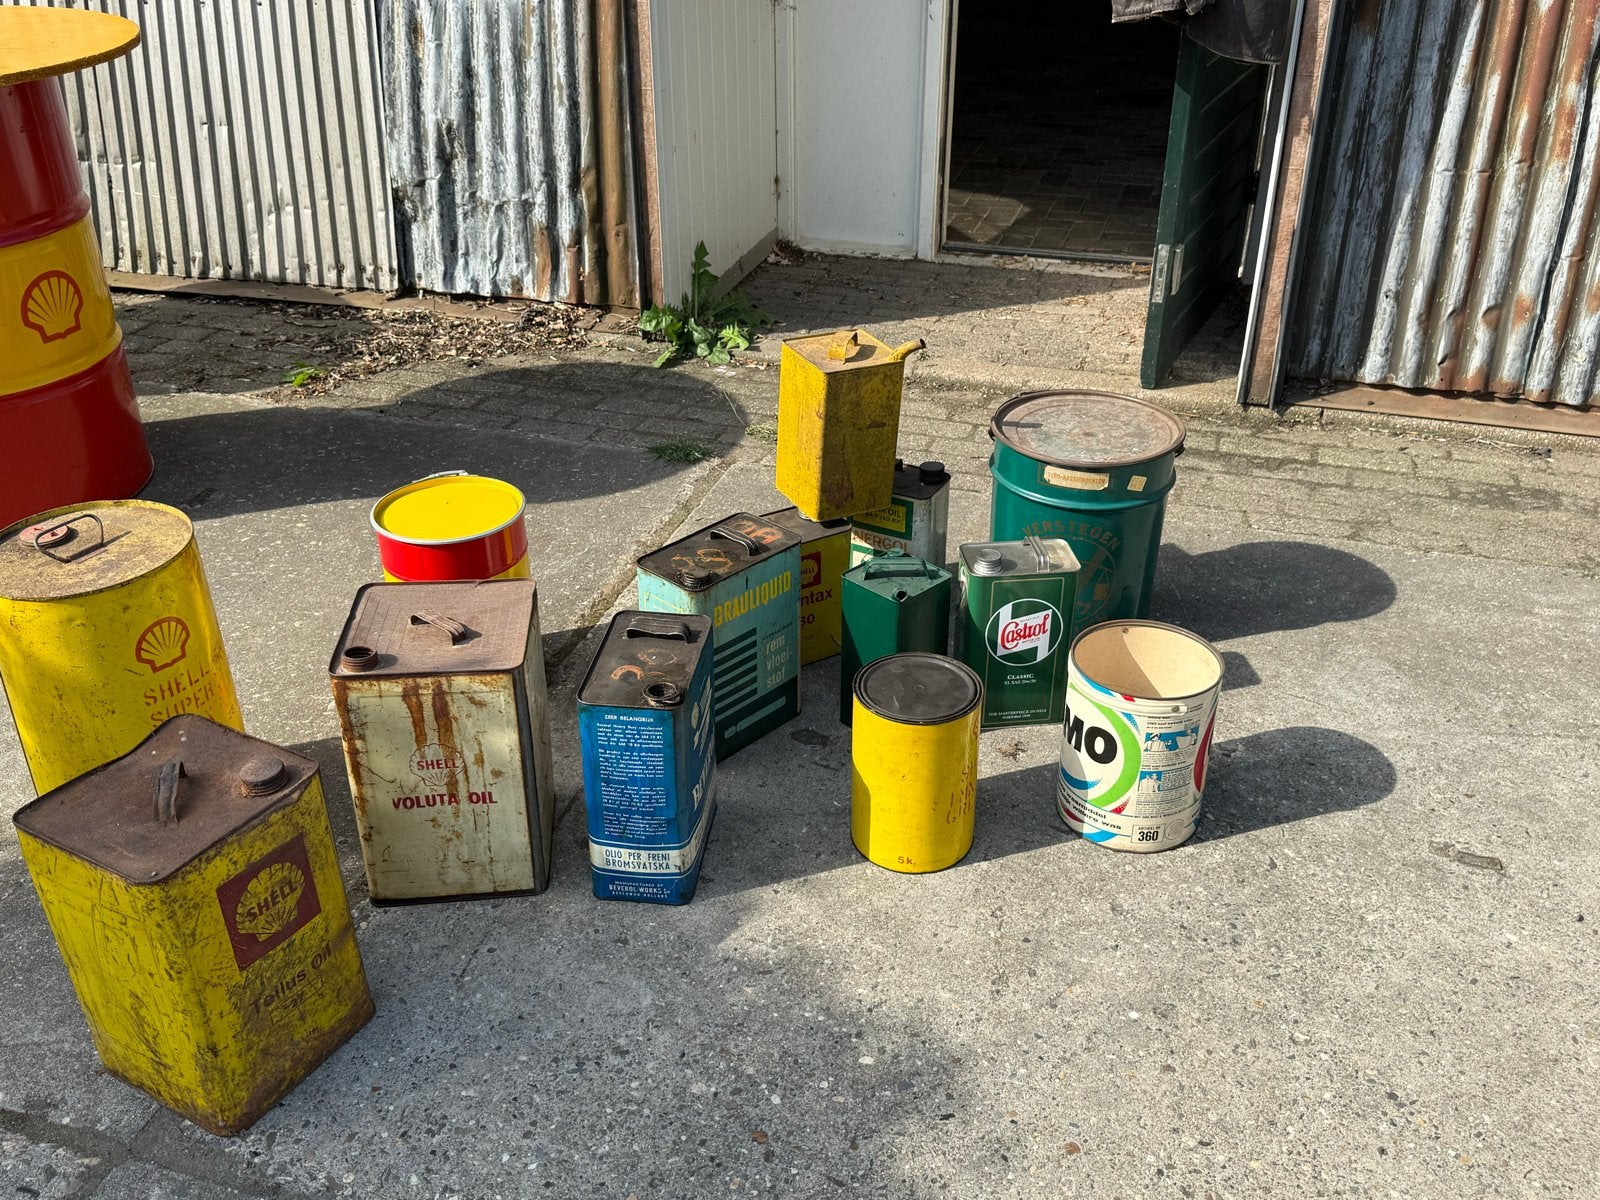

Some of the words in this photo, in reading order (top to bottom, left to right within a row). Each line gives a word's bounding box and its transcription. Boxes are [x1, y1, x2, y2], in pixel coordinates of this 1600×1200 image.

[853, 530, 907, 553] NERGOL
[1022, 520, 1122, 551] VERSTEGEN
[801, 567, 815, 576] HELL
[713, 570, 791, 627] BRAULIQUID
[800, 588, 833, 607] ntax
[1001, 613, 1050, 650] Castrol
[766, 635, 784, 654] rem
[144, 661, 210, 707] SHELL
[766, 665, 786, 688] stof
[1063, 702, 1118, 765] MO
[416, 758, 459, 771] SHELL
[392, 793, 460, 810] VOLUTA
[467, 791, 498, 805] OIL
[1101, 820, 1122, 830] was
[1138, 830, 1159, 842] 360
[605, 849, 623, 859] OLIO
[628, 852, 642, 860] PER
[647, 853, 670, 861] FRENI
[605, 858, 671, 870] BROMSVATSKA
[245, 878, 298, 924] SHELL
[249, 969, 307, 1014] Tellus
[310, 943, 332, 970] Oil
